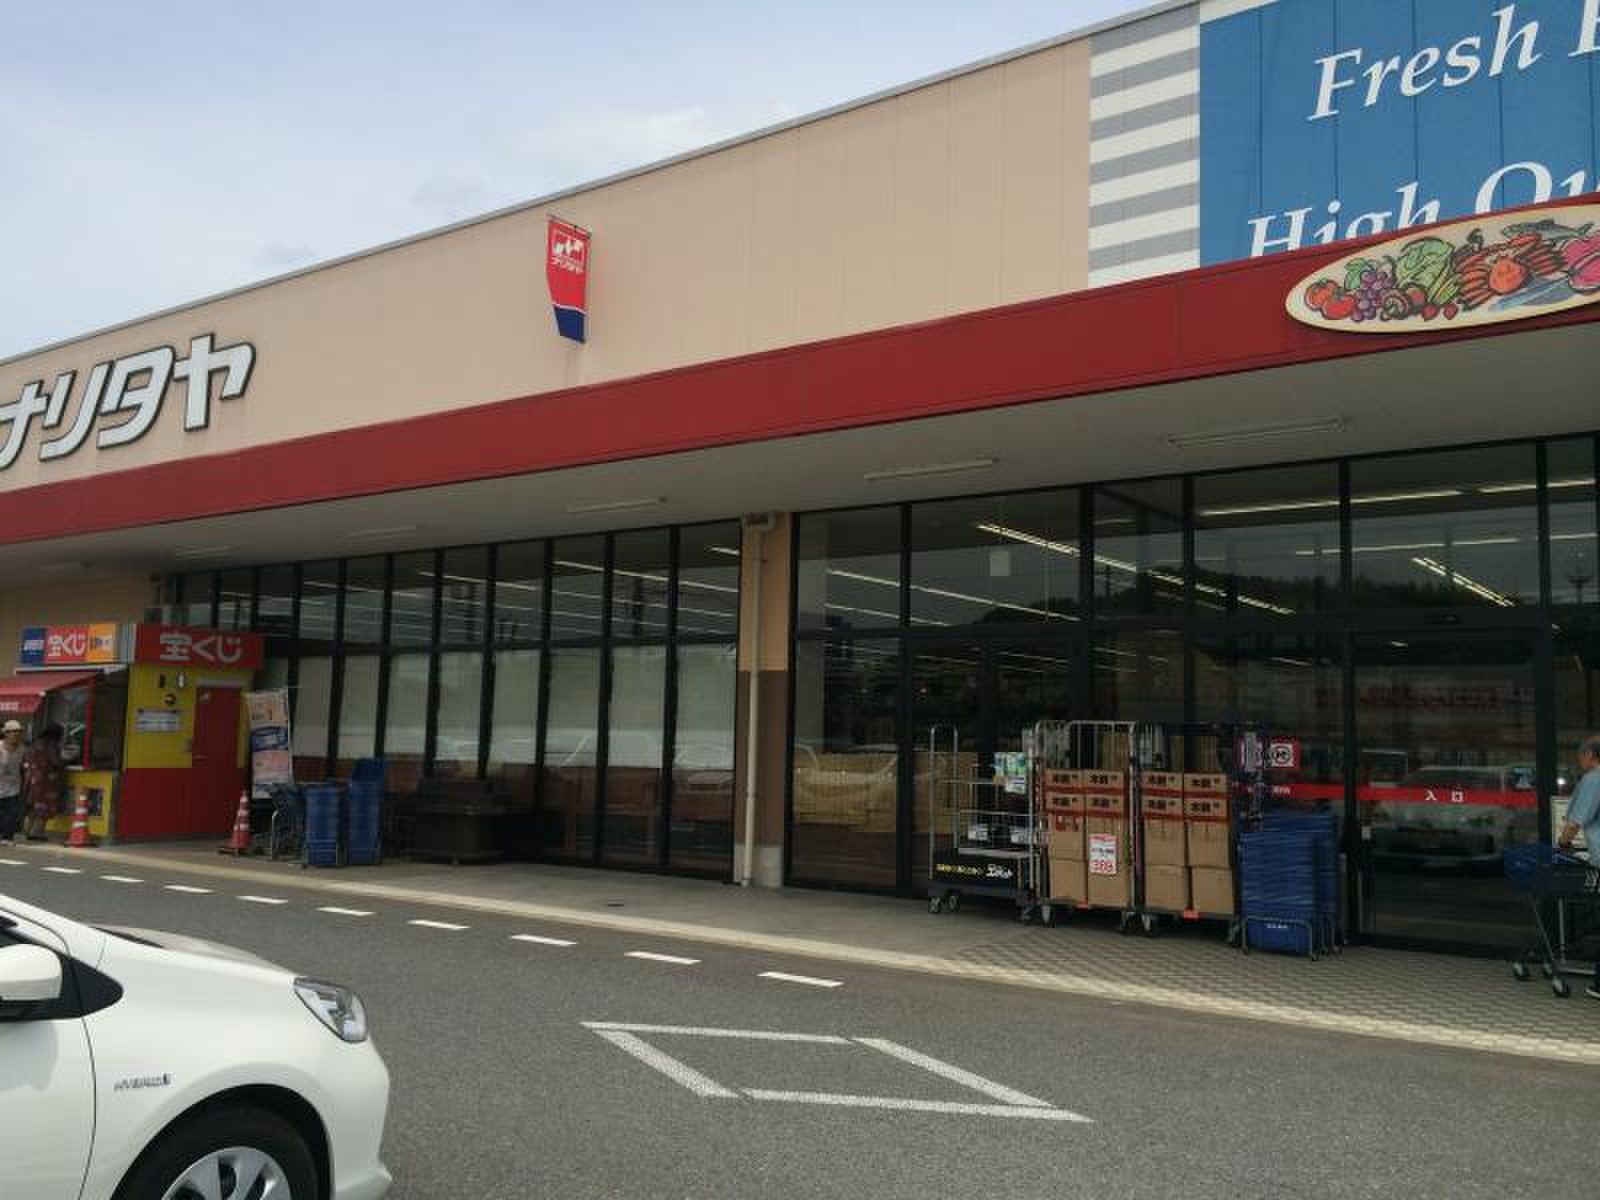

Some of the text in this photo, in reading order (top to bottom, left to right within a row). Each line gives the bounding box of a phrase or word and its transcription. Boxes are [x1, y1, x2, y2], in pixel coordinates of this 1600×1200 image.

[1307, 4, 1543, 121] Fresh
[0, 332, 256, 472] ナリタヤ
[48, 633, 87, 658] 宝くじ
[159, 632, 243, 663] 宝くじ
[1424, 788, 1465, 803] 入口
